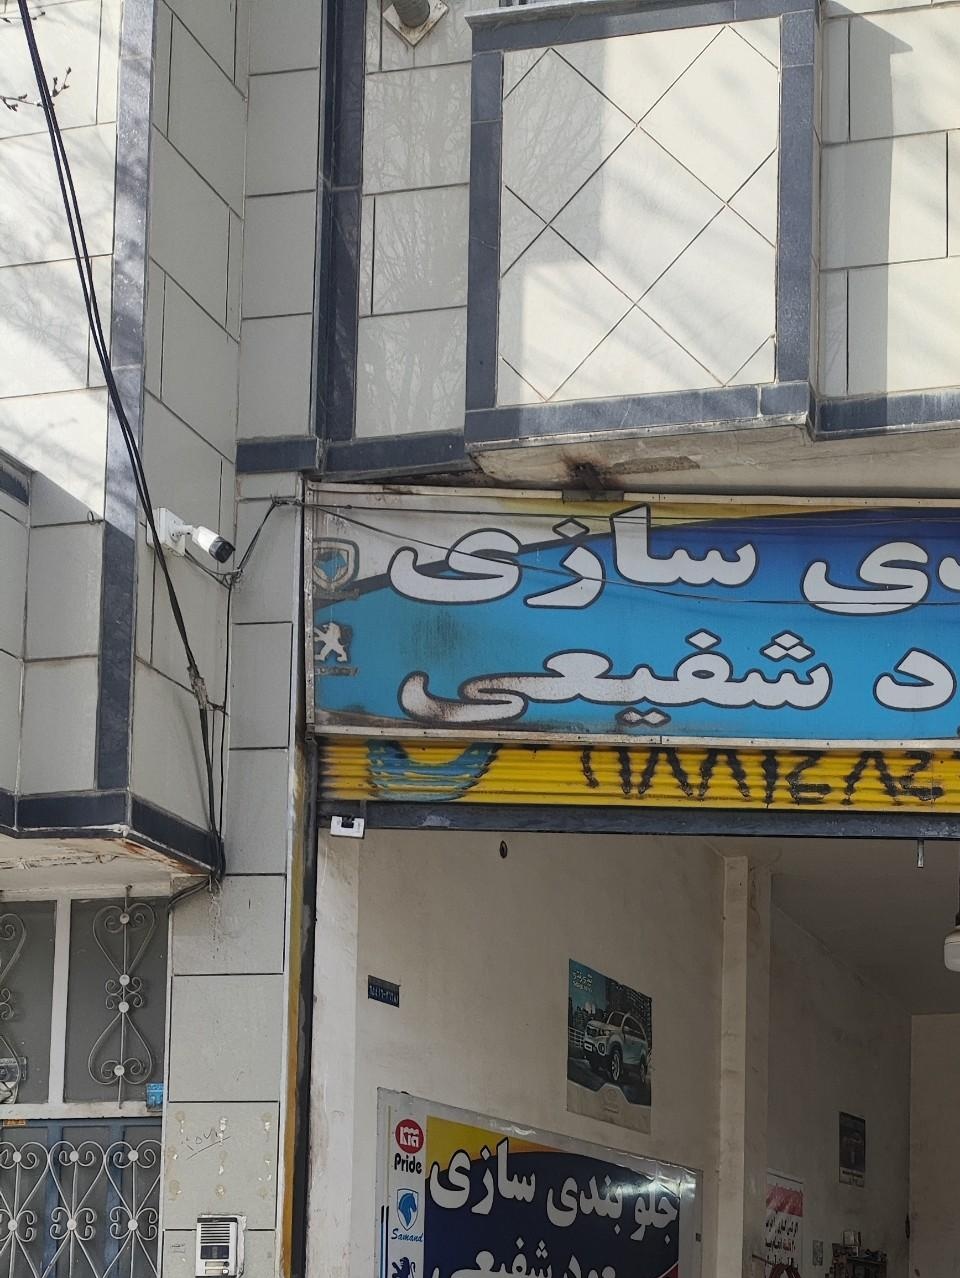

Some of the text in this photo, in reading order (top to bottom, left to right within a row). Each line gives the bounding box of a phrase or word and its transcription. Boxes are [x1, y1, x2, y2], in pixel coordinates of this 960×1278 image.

[387, 503, 757, 610] سازی
[399, 628, 832, 727] شفیعی
[393, 1152, 422, 1175] Pride
[429, 1136, 536, 1217] سازی
[391, 1227, 423, 1243] Samand
